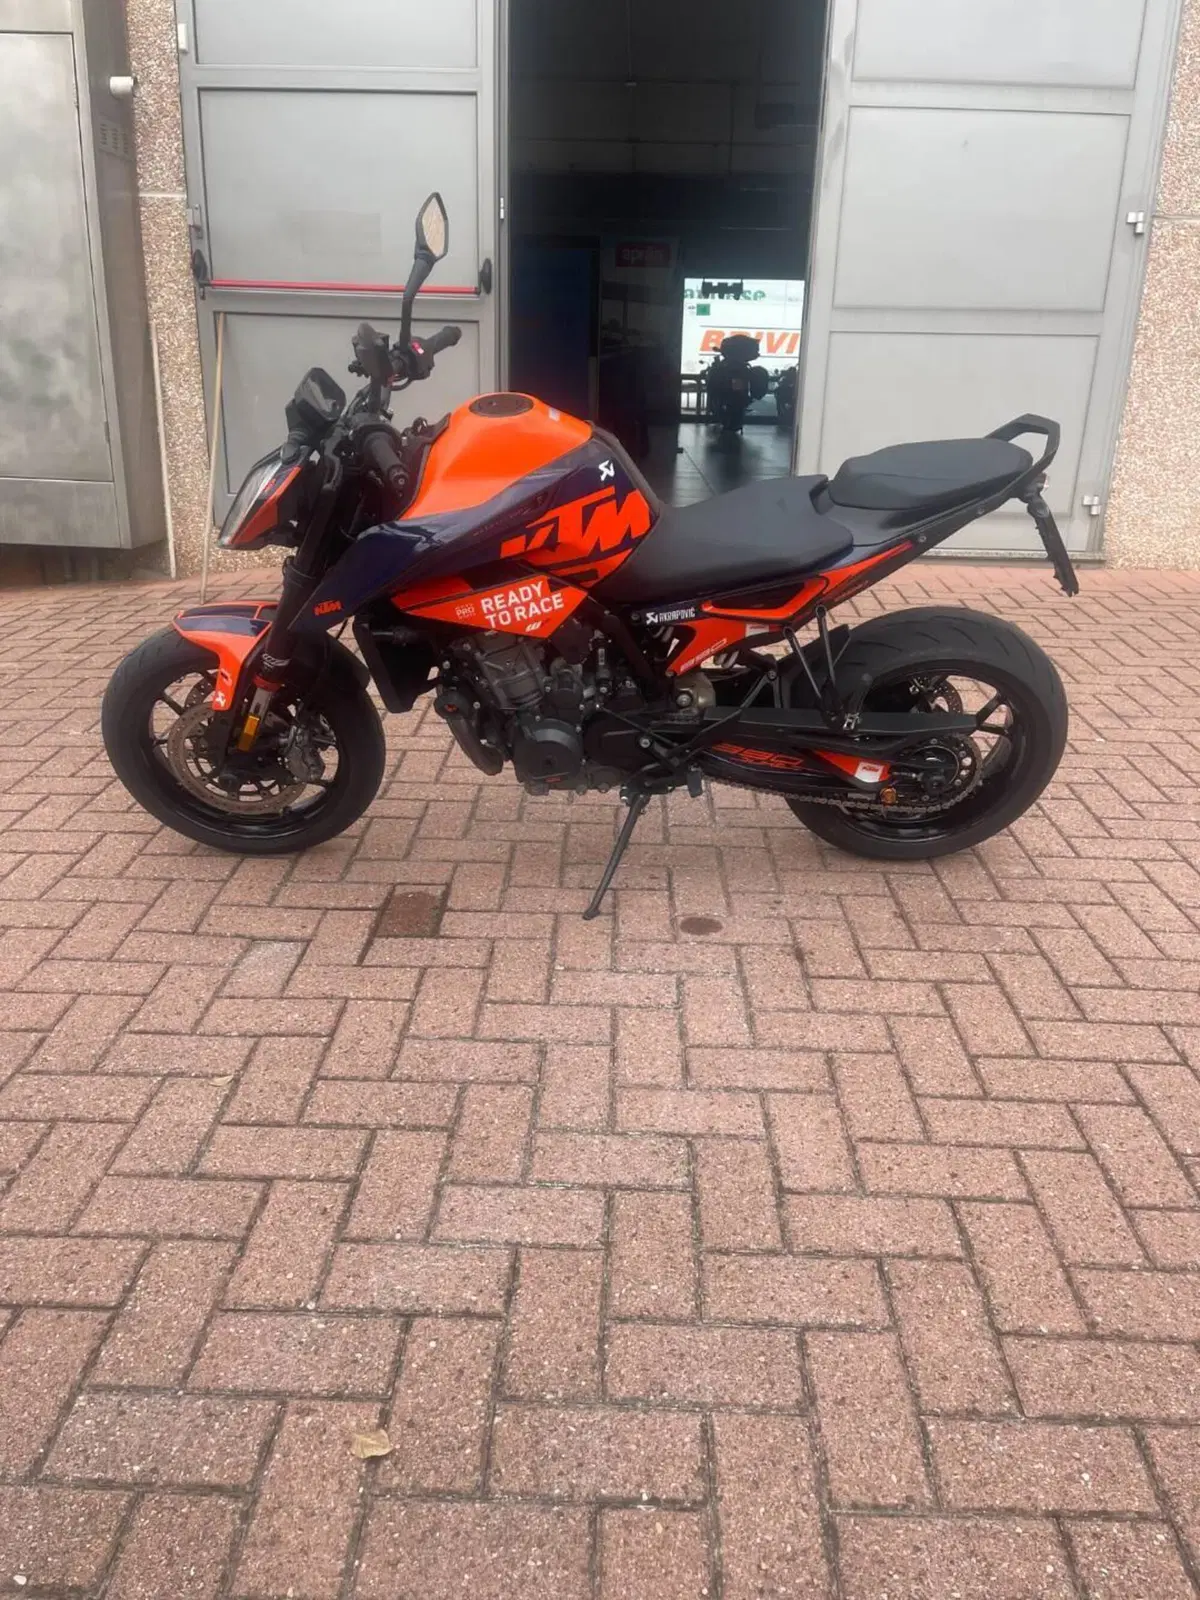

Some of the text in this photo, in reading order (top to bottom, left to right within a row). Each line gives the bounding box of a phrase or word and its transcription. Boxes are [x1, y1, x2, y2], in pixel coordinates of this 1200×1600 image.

[699, 329, 800, 354] BIVI
[501, 485, 651, 559] KTM
[313, 600, 343, 616] KTM
[481, 581, 543, 614] READY
[485, 610, 512, 629] TO
[514, 593, 564, 621] RACE
